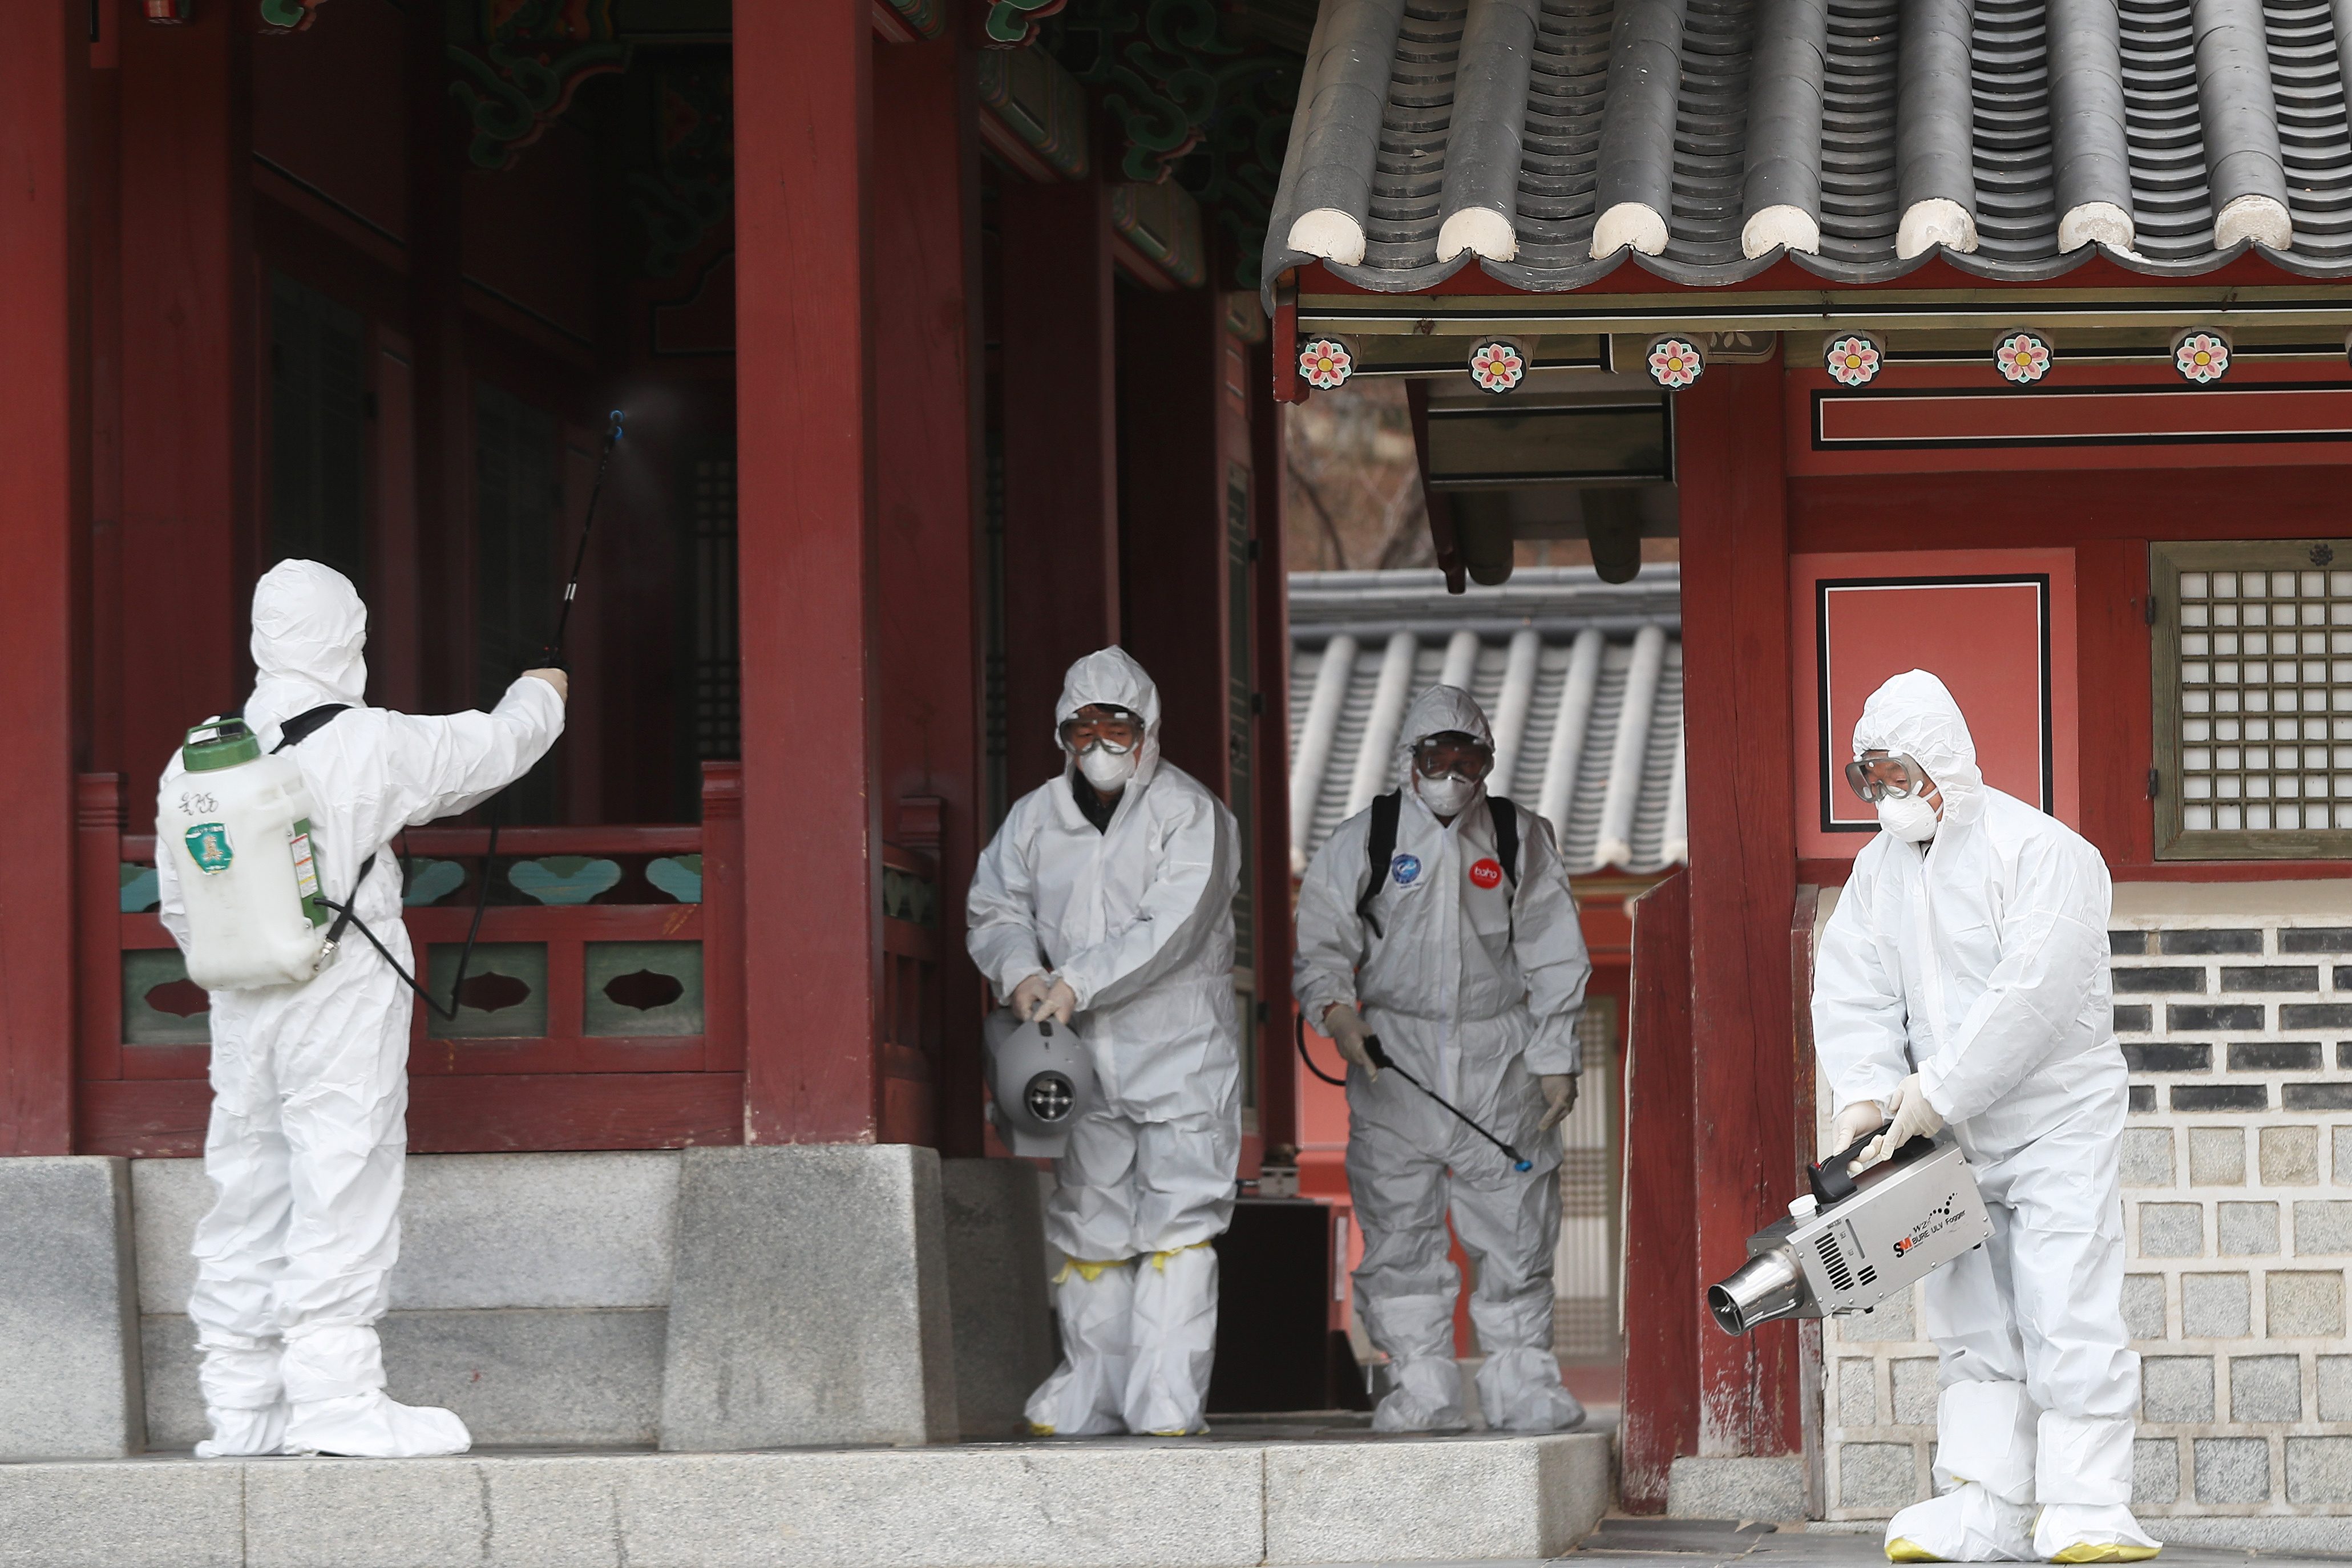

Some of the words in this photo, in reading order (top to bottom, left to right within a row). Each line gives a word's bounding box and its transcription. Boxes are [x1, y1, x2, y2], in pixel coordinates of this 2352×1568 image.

[1911, 1230, 1930, 1244] BURE
[1930, 1222, 1943, 1233] ULV
[1945, 1210, 1965, 1225] Fogger
